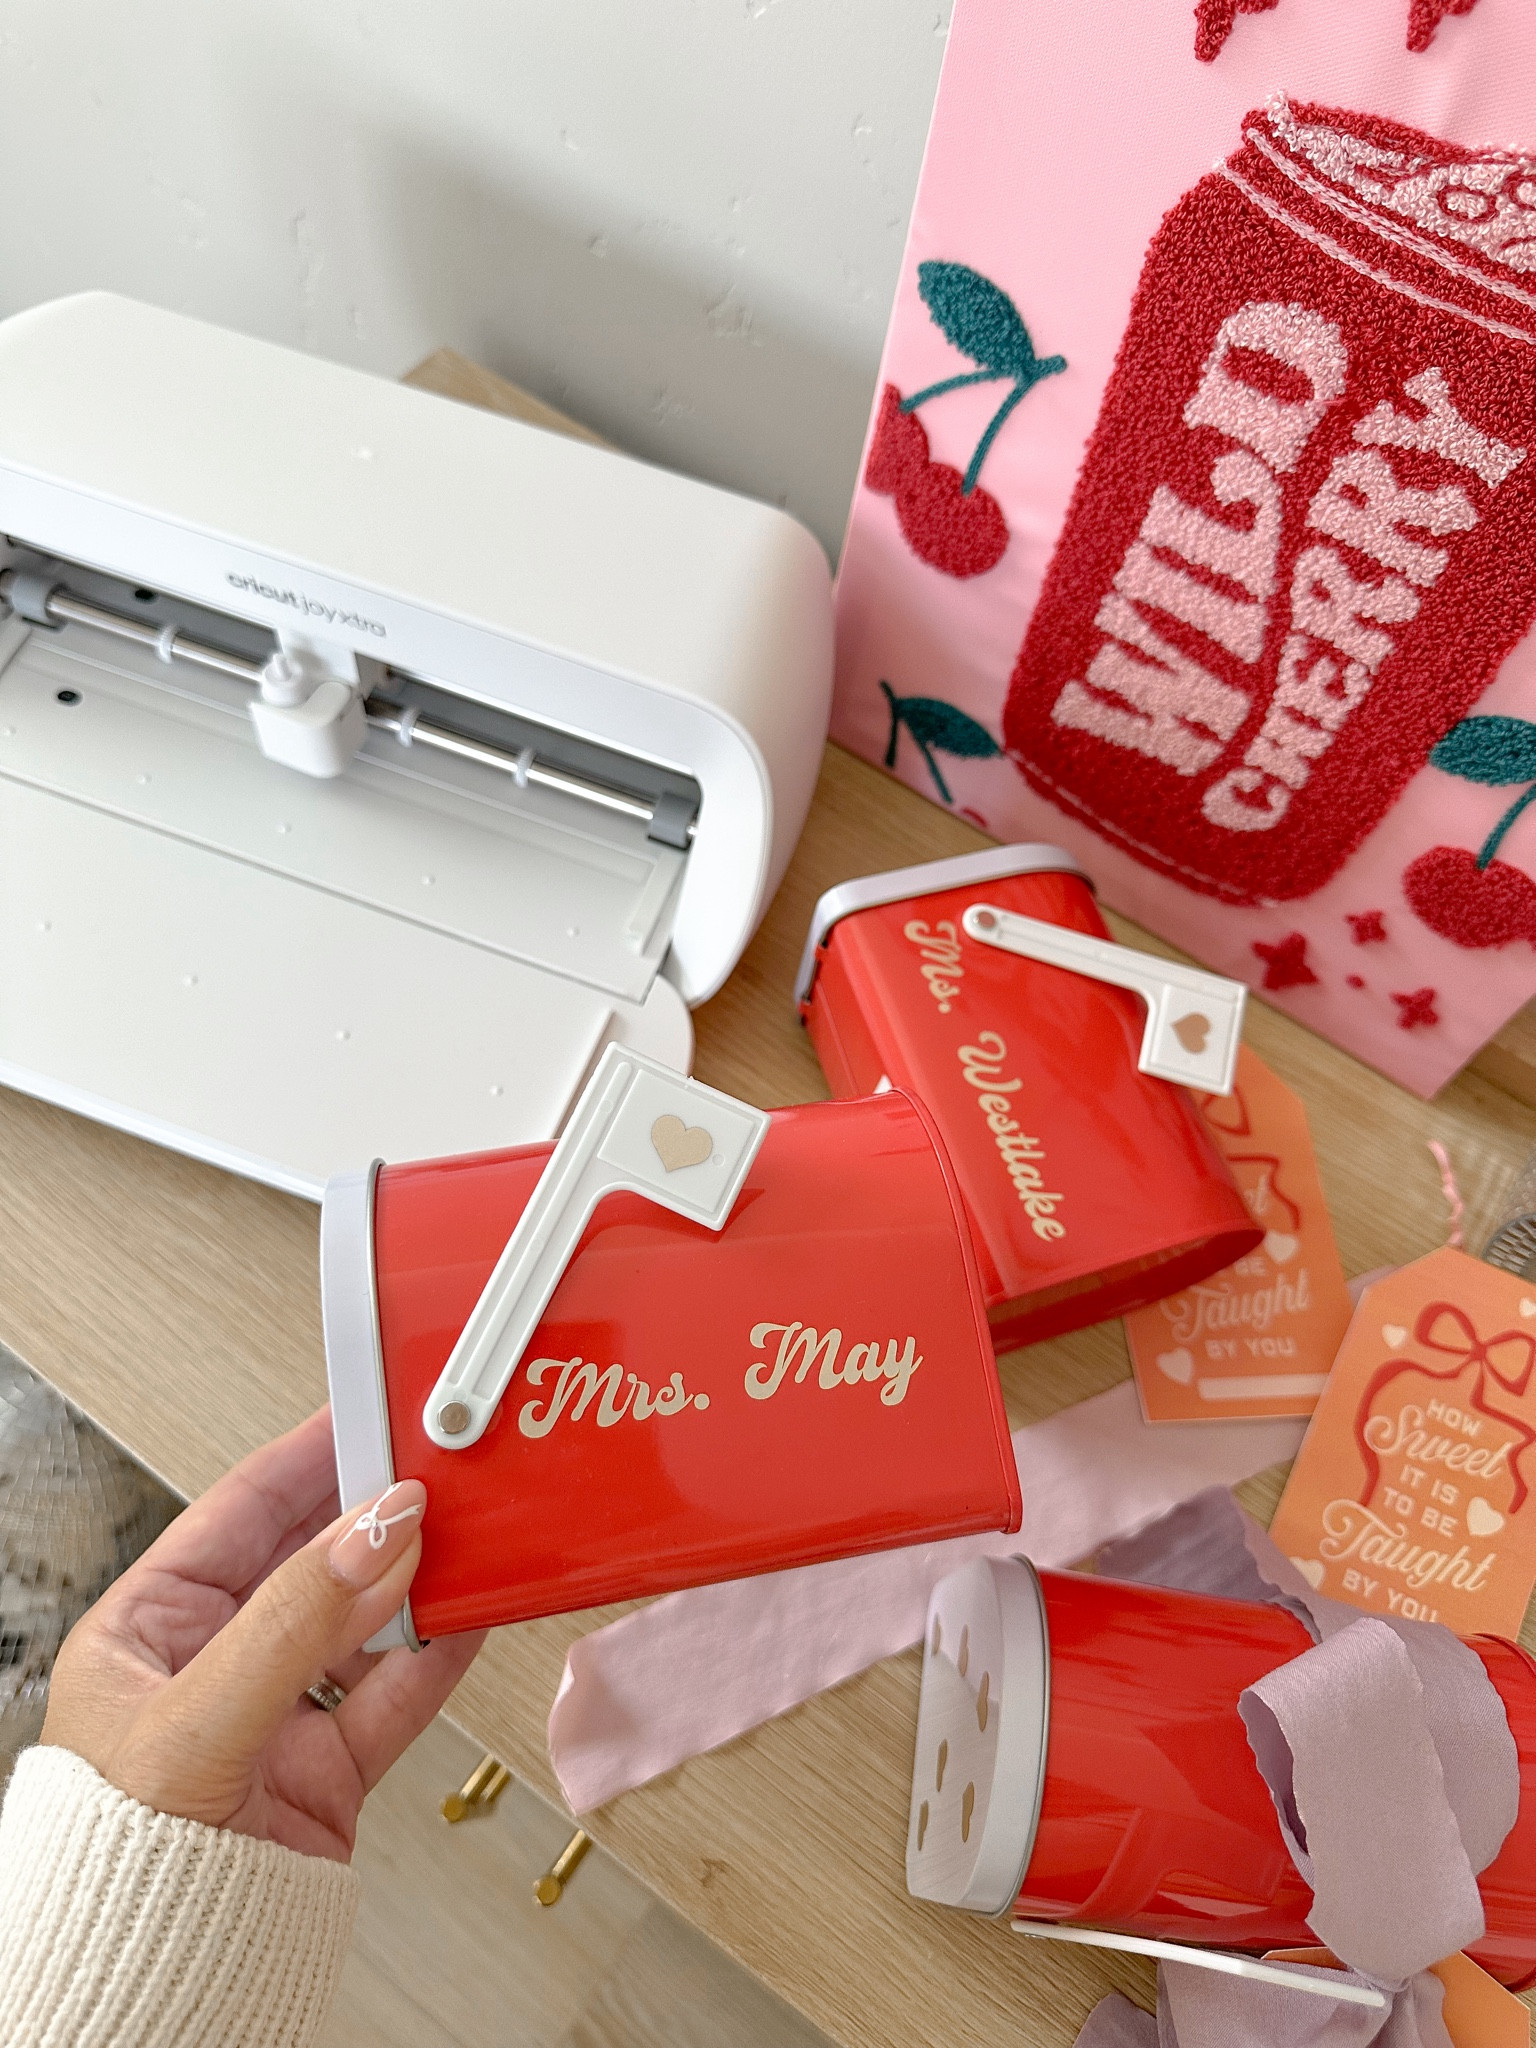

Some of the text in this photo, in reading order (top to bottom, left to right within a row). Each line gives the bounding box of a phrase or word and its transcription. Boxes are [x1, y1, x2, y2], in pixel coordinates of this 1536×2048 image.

[1049, 300, 1349, 777] WILD
[226, 571, 301, 609] cricut
[301, 590, 338, 624] joy
[1202, 365, 1528, 833] CHERRY
[903, 919, 1067, 1242] Ms. Westlake
[1160, 1268, 1310, 1343] Taught
[518, 1321, 925, 1438] Mrs. May
[1205, 1336, 1297, 1359] BY YOU
[1363, 1404, 1513, 1479] Sweet
[1427, 1399, 1483, 1437] HOW
[1383, 1486, 1458, 1538] TO BE
[1400, 1464, 1460, 1506] IT IS
[1319, 1498, 1497, 1592] Taught
[1341, 1568, 1380, 1598] BY
